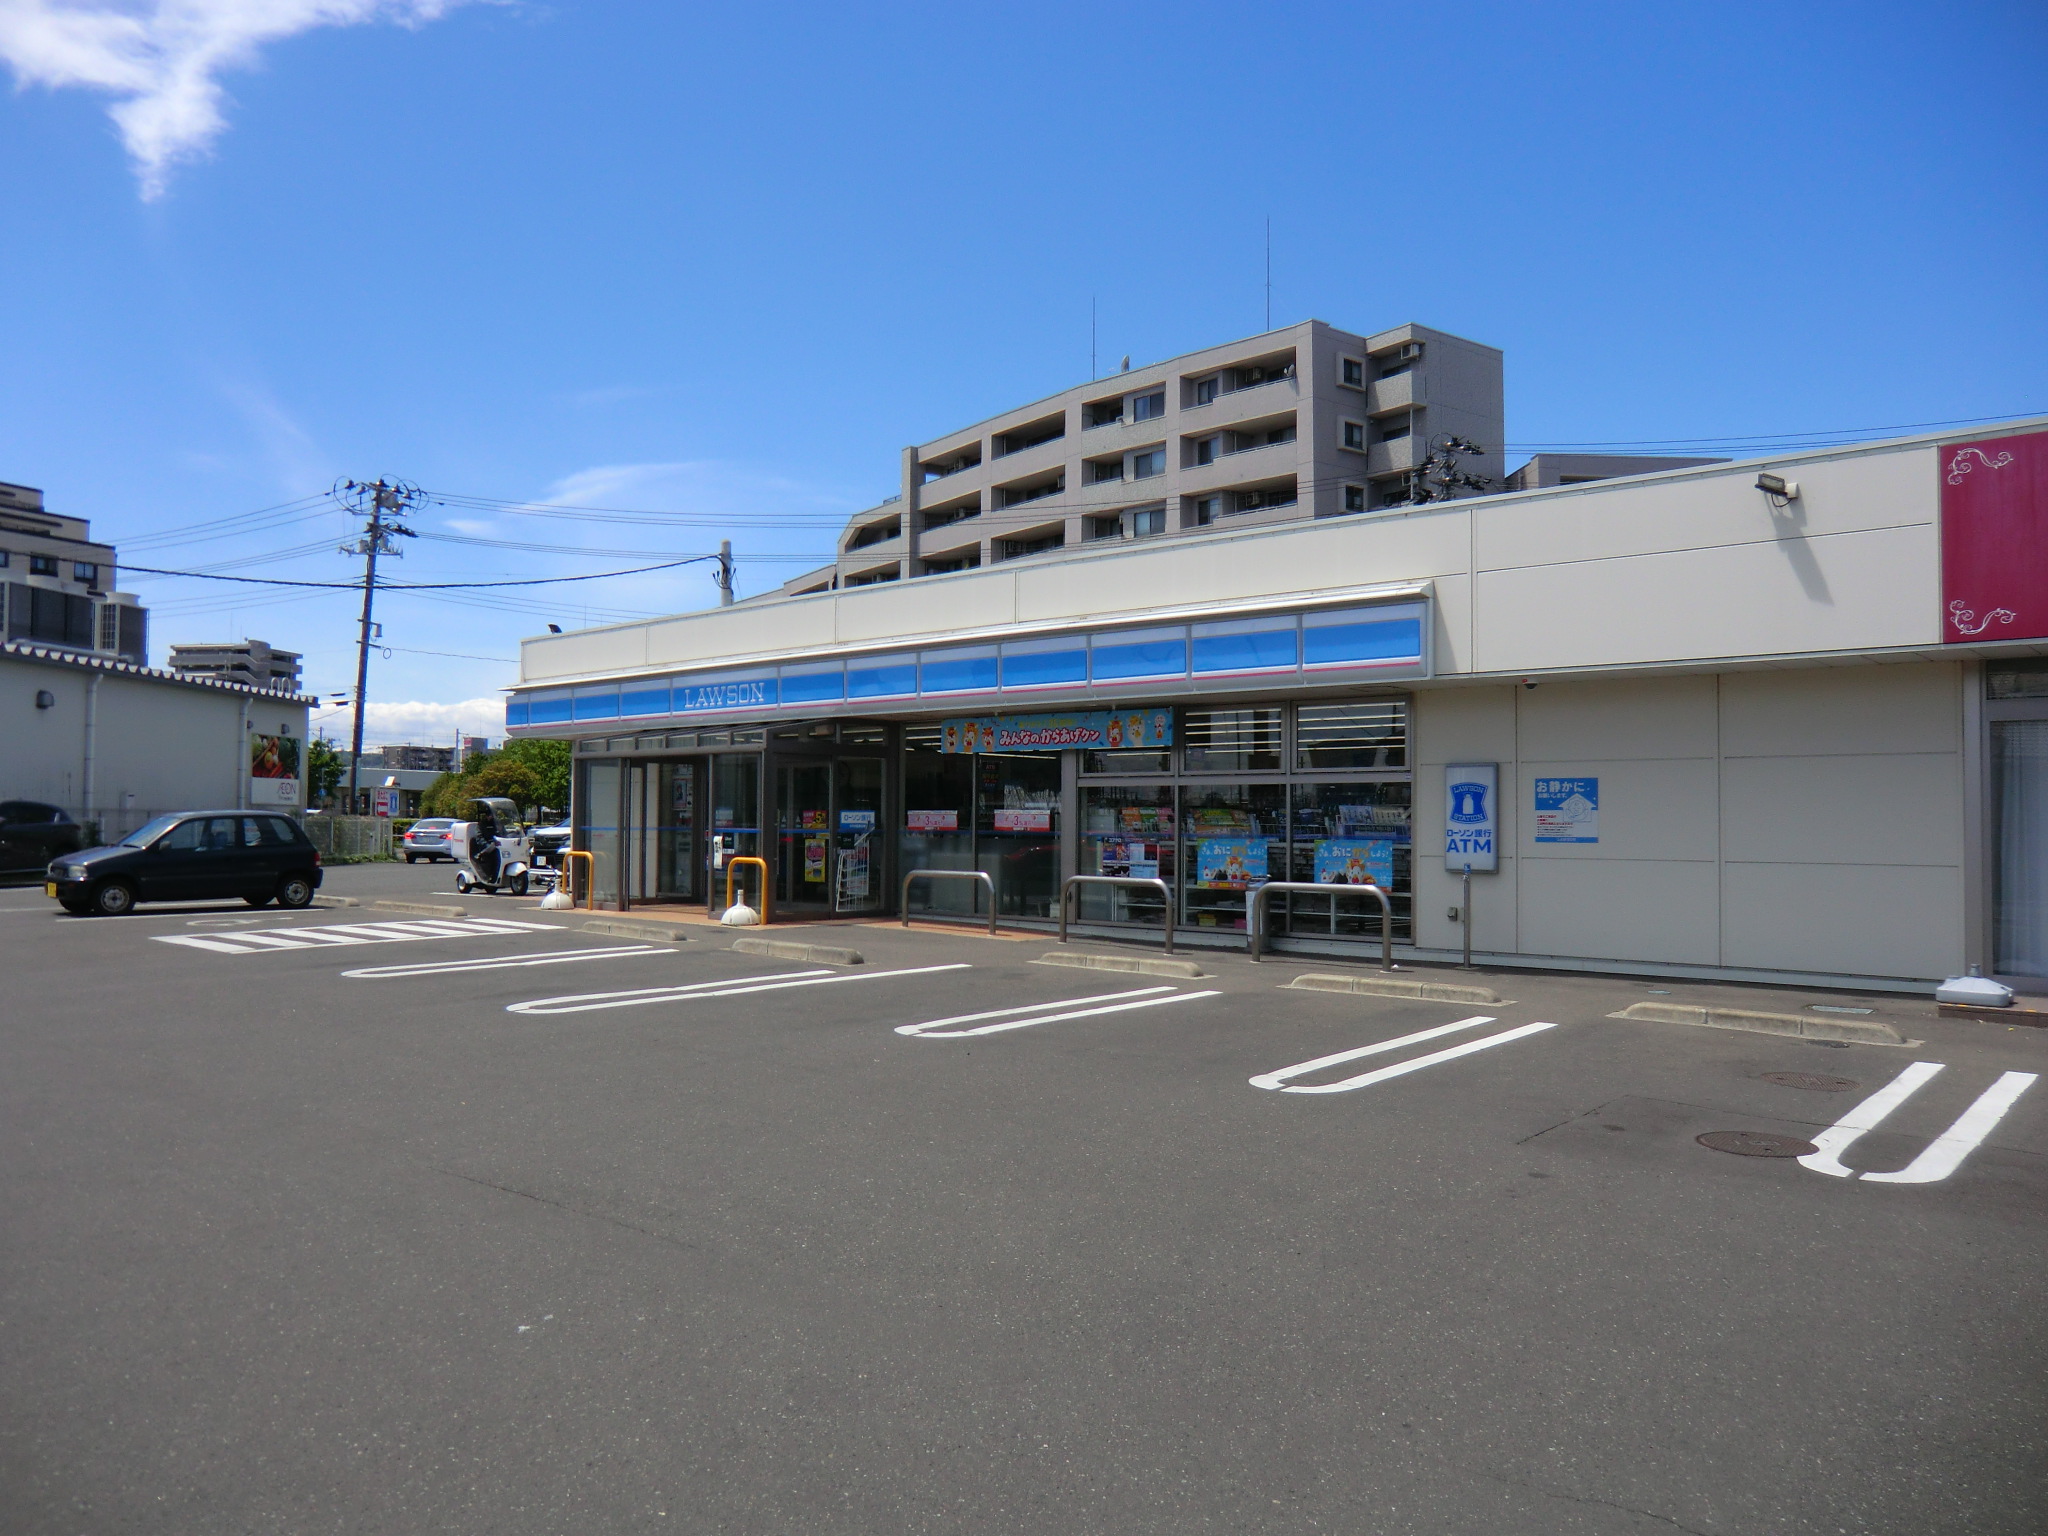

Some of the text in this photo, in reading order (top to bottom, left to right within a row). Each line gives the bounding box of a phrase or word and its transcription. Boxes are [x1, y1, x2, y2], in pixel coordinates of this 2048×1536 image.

[684, 682, 765, 708] LAWSON
[999, 727, 1100, 746] みんなのからあげクン
[1453, 785, 1485, 794] LAWSON
[1536, 780, 1585, 793] お静かに
[1453, 813, 1484, 821] STATION
[1446, 828, 1492, 838] ローソン銀行
[1446, 838, 1492, 854] ATM
